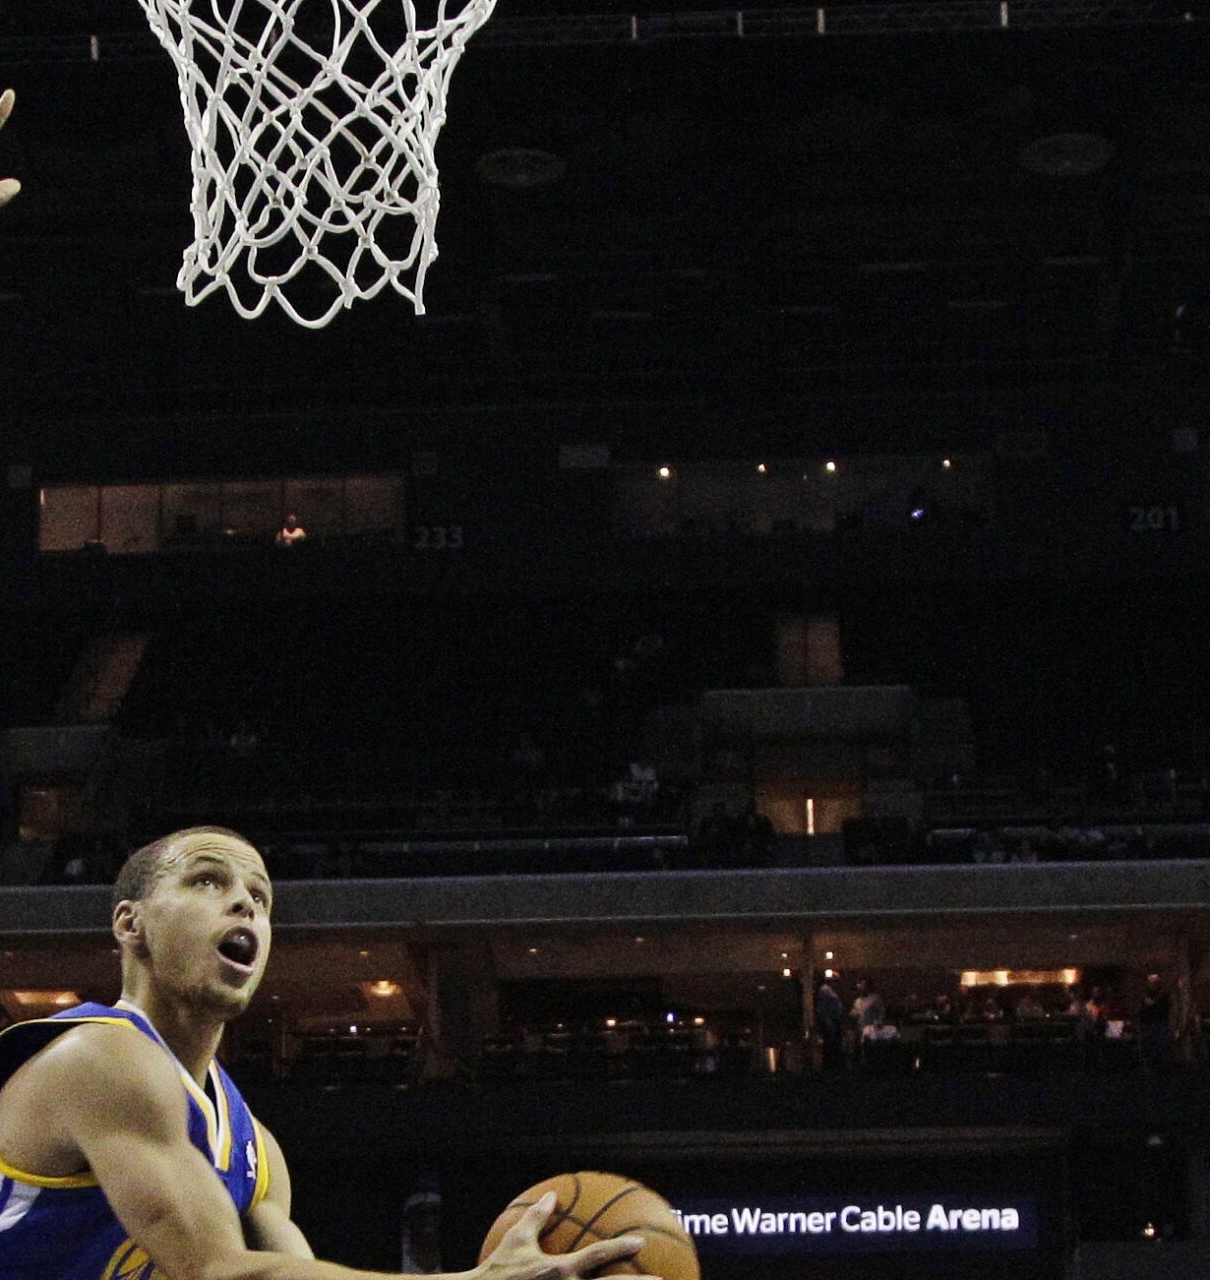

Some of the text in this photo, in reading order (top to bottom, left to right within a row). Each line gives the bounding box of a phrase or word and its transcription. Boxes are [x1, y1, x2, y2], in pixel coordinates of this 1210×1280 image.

[1129, 506, 1178, 530] 201
[671, 1203, 1020, 1234] ime Warner Cable Arena
